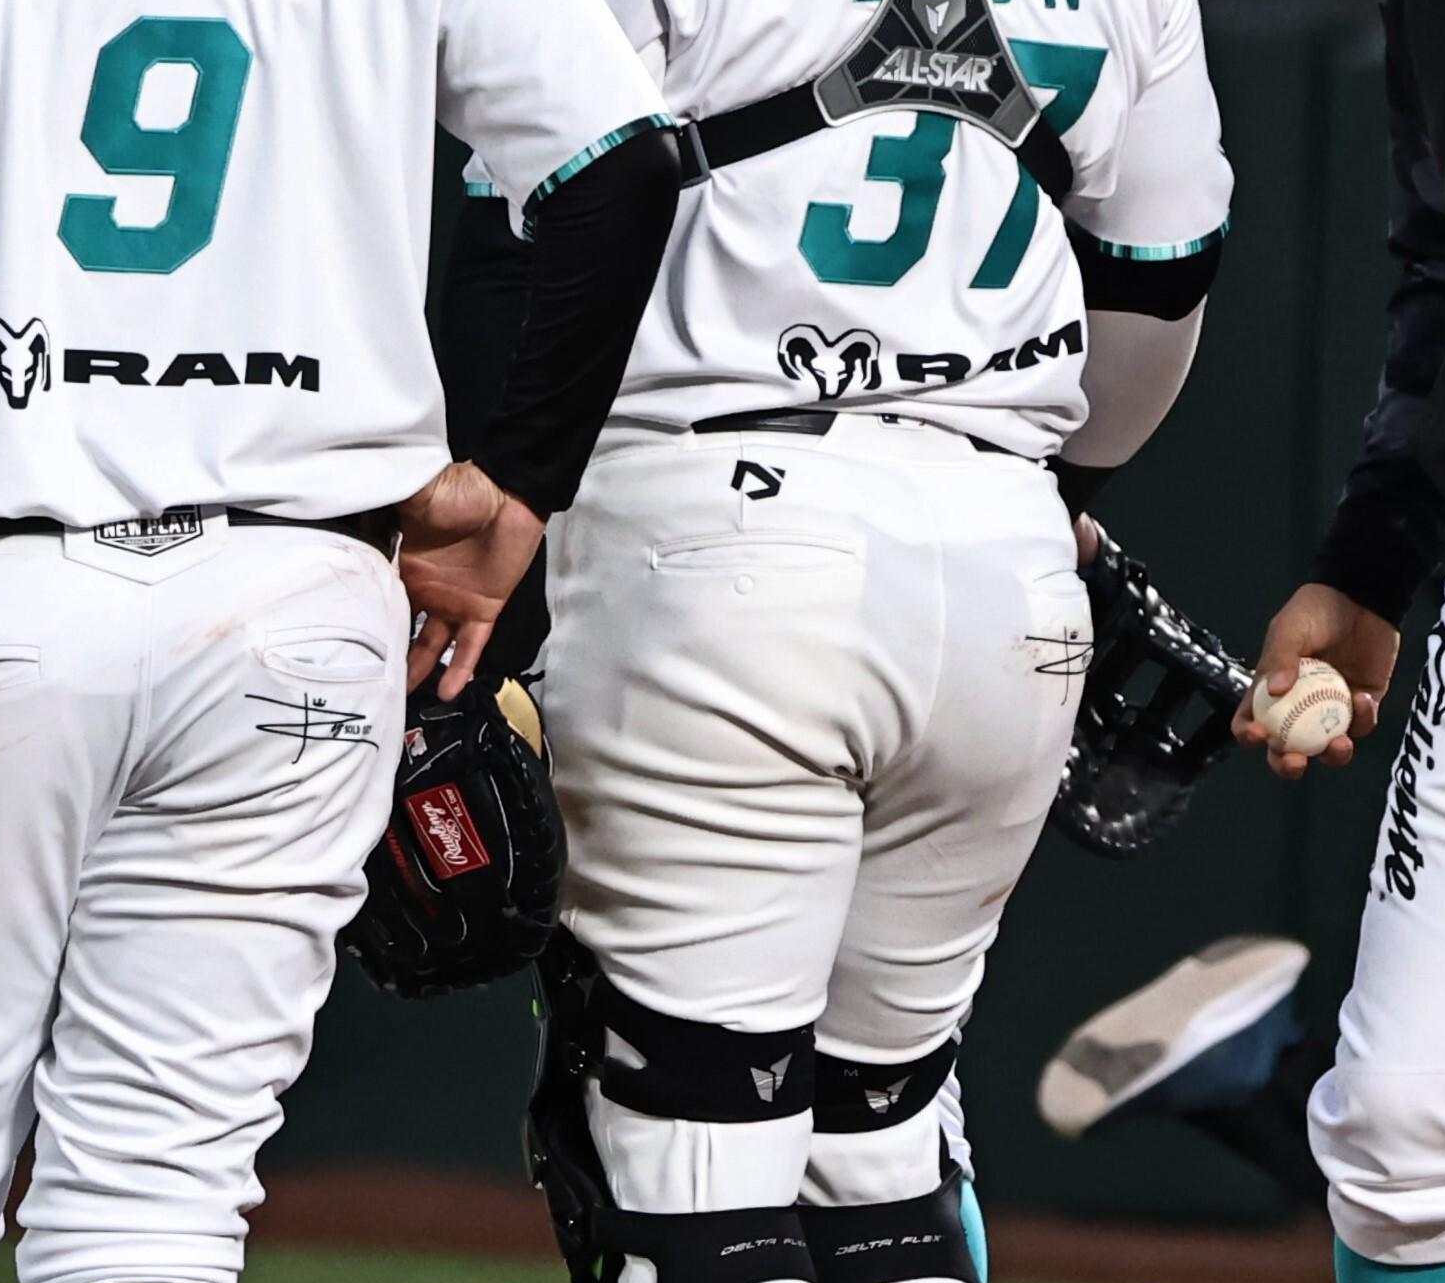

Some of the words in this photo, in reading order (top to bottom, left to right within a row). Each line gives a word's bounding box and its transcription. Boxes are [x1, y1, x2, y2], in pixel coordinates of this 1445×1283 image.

[872, 47, 994, 93] ALL-STAR
[57, 15, 254, 275] 9
[798, 37, 1108, 290] 37
[62, 348, 321, 393] RAM
[420, 799, 469, 866] Rawlings
[720, 1237, 778, 1257] DELTA
[834, 1237, 894, 1257] DELTA
